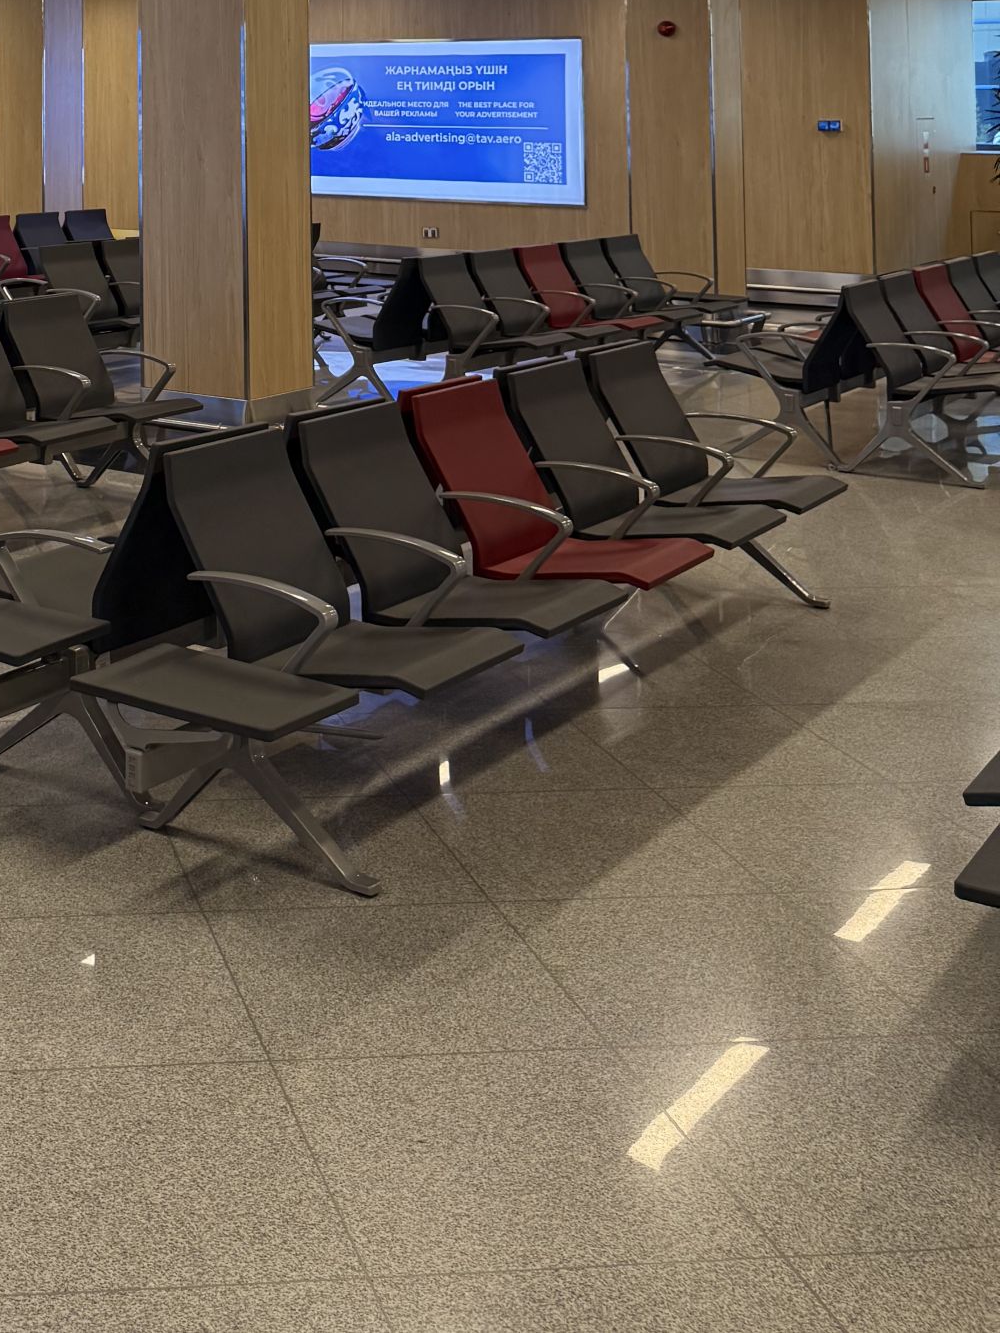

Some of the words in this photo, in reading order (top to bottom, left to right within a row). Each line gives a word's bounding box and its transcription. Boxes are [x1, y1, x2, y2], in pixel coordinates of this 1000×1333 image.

[385, 65, 473, 77] ЖАРНАМАҢЫЗ
[475, 65, 508, 75] ҮШІН
[397, 81, 413, 92] ЕҢ
[415, 81, 456, 92] ТИІМДІ
[458, 81, 495, 91] ОРЫН
[363, 100, 406, 108] ИДЕАЛЬНОЕ
[433, 101, 449, 109] ДЛЯ
[473, 101, 492, 109] BEST
[493, 101, 517, 109] PLACE
[374, 109, 400, 117] ВАШЕЙ
[476, 111, 538, 119] ADVERTISEMENT
[385, 131, 522, 145] ala-advertising@tav.aero
